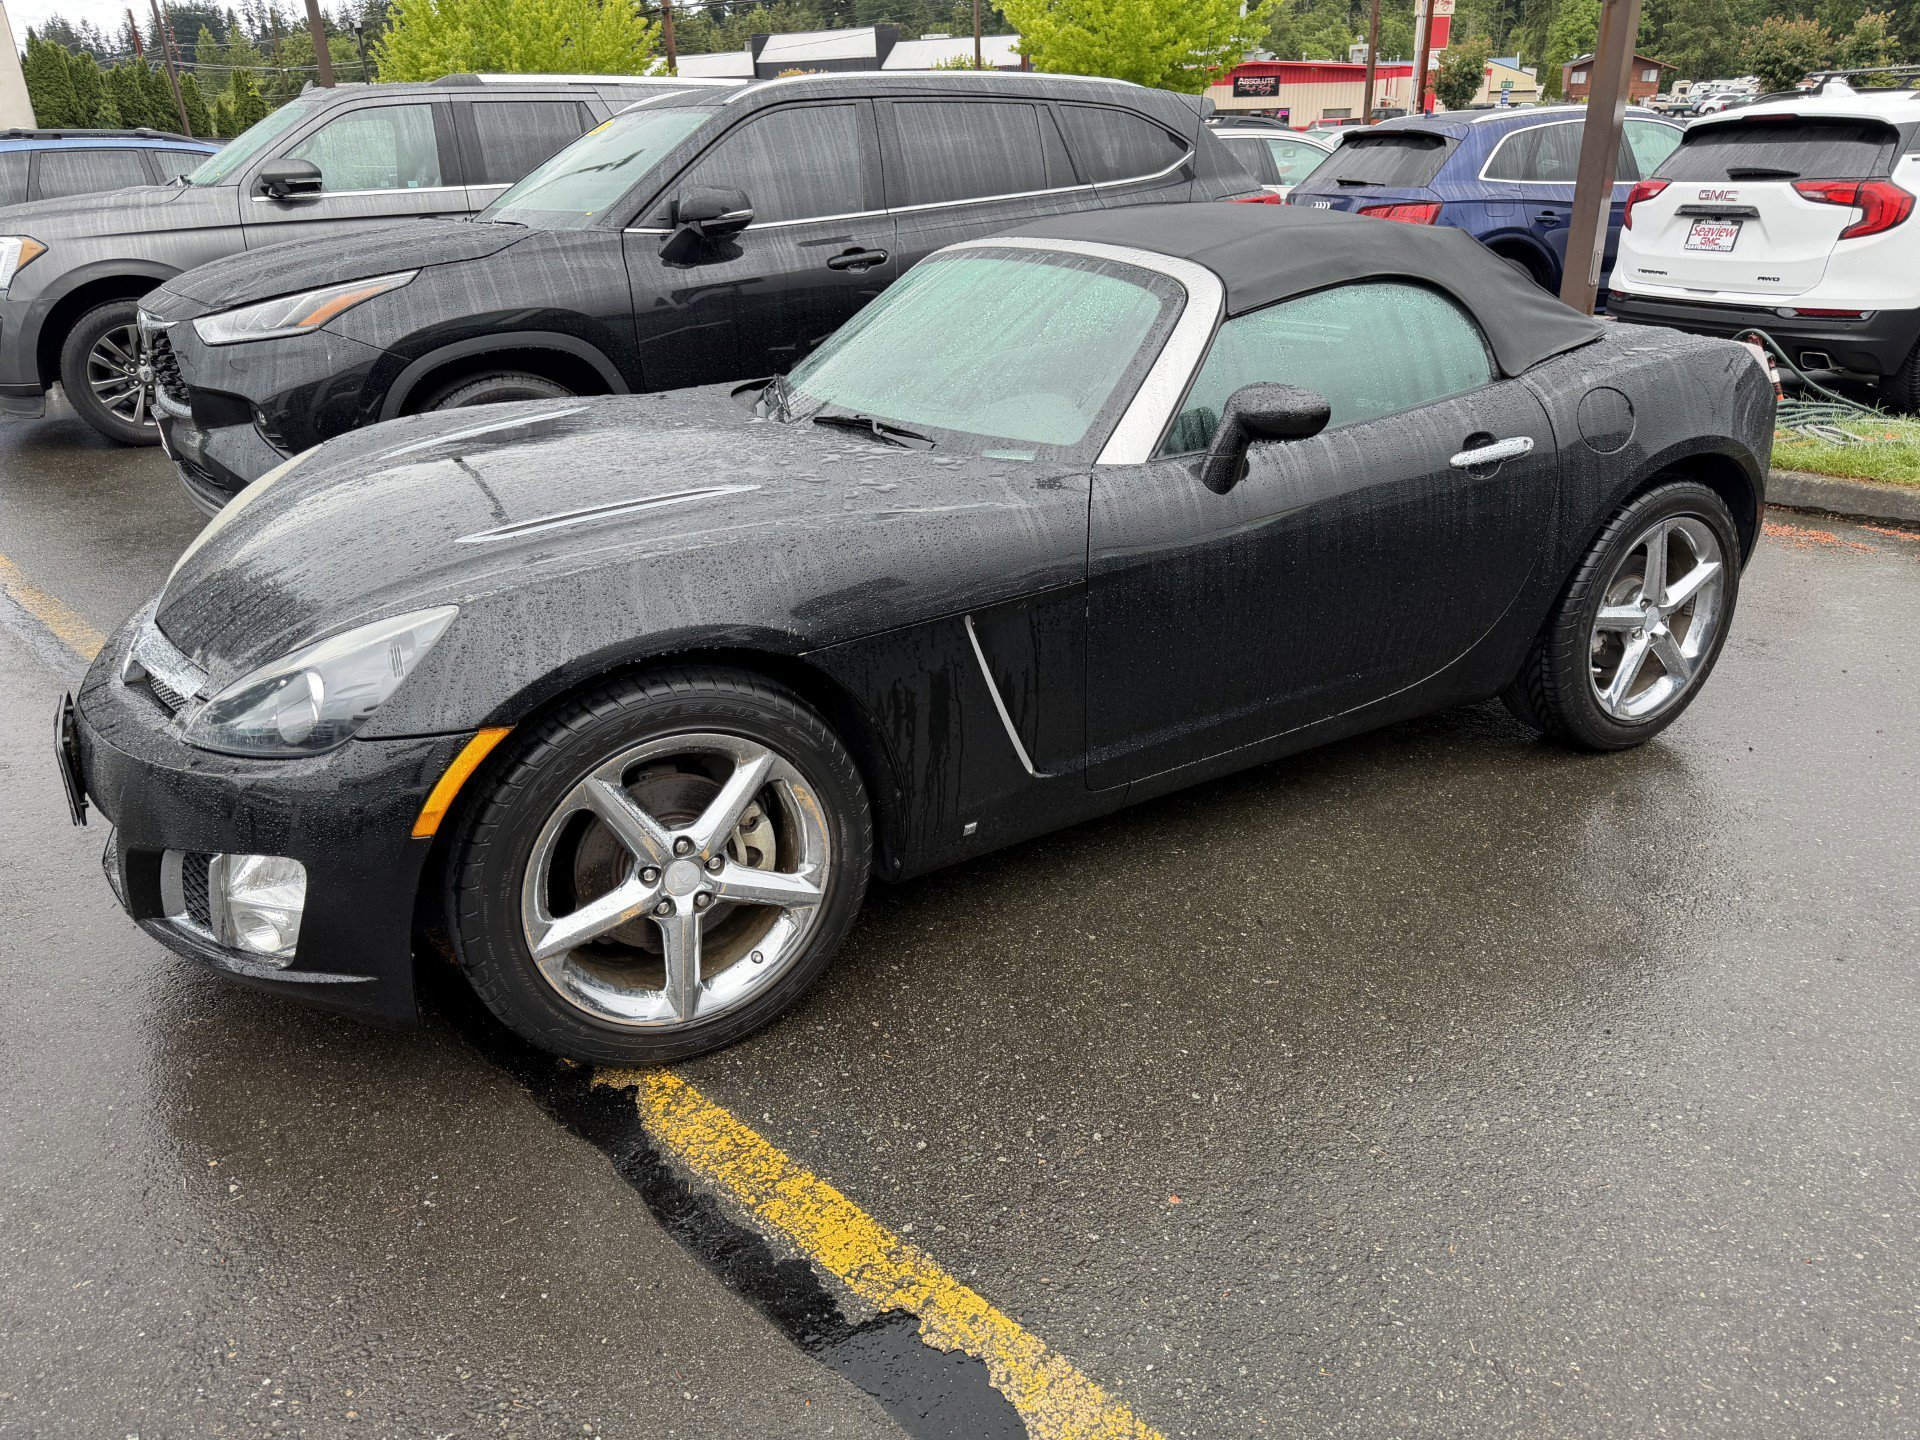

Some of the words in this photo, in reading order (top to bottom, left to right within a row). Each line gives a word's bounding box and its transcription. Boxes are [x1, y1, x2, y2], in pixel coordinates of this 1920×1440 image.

[1237, 77, 1276, 85] ABSOLUTE
[1698, 189, 1739, 202] GMC
[1691, 224, 1738, 238] Seaview
[1699, 237, 1721, 246] GMC
[1637, 268, 1668, 276] TERRAIN
[535, 702, 763, 794] GOODYEAR
